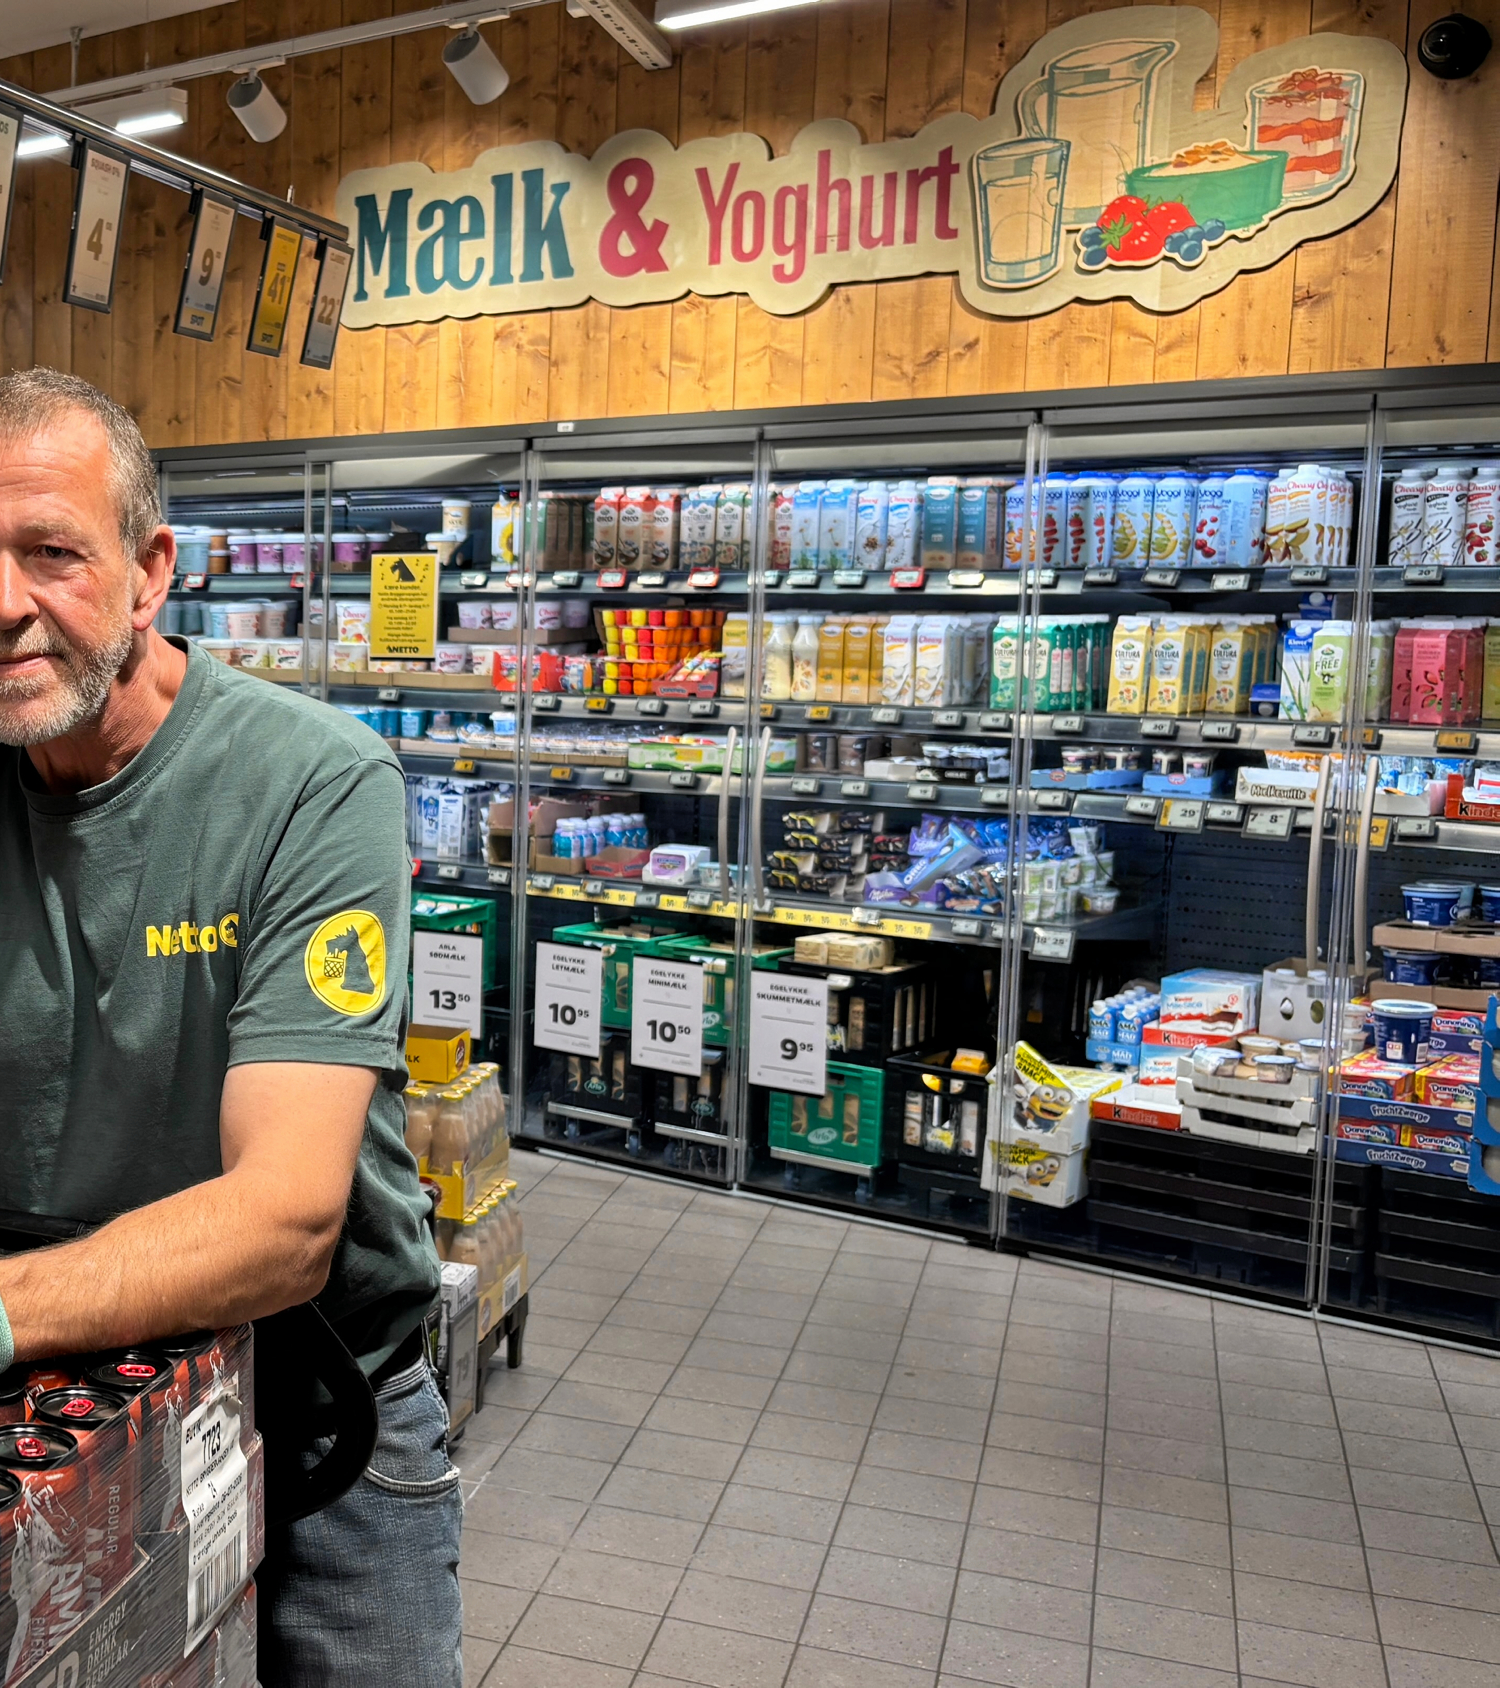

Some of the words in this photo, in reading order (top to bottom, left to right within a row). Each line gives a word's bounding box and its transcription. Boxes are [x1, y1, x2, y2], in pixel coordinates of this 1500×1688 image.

[353, 167, 574, 302] Mælk
[599, 157, 670, 278] &
[696, 145, 959, 284] Yoghurt
[87, 218, 104, 261] 4
[198, 248, 214, 286] 9
[393, 646, 419, 654] NETTO
[1315, 659, 1340, 670] FREE
[146, 922, 217, 957] Netto
[429, 952, 466, 961] SØDMÆLK
[552, 964, 585, 975] LETMÆLK
[651, 970, 685, 980] EGELYKKE
[648, 979, 687, 990] MINIMÆLK
[770, 984, 808, 995] EGELYKKE
[429, 990, 457, 1010] 13
[458, 994, 470, 1002] 50
[757, 992, 821, 1007] SKUMMETMÆLK
[548, 1003, 576, 1025] 10
[578, 1009, 589, 1018] 95
[1435, 1017, 1475, 1029] Danonino
[646, 1020, 677, 1043] 10
[678, 1026, 690, 1035] 50
[780, 1039, 798, 1060] 9
[799, 1043, 813, 1052] 95
[1016, 1063, 1046, 1086] SNACK
[1341, 1081, 1382, 1093] Danonino
[1431, 1083, 1473, 1097] Danonino
[1342, 1124, 1386, 1138] Danonino
[1417, 1134, 1459, 1150] Danonino
[107, 1484, 120, 1554] REGULAR
[88, 1599, 127, 1652] ENERGY
